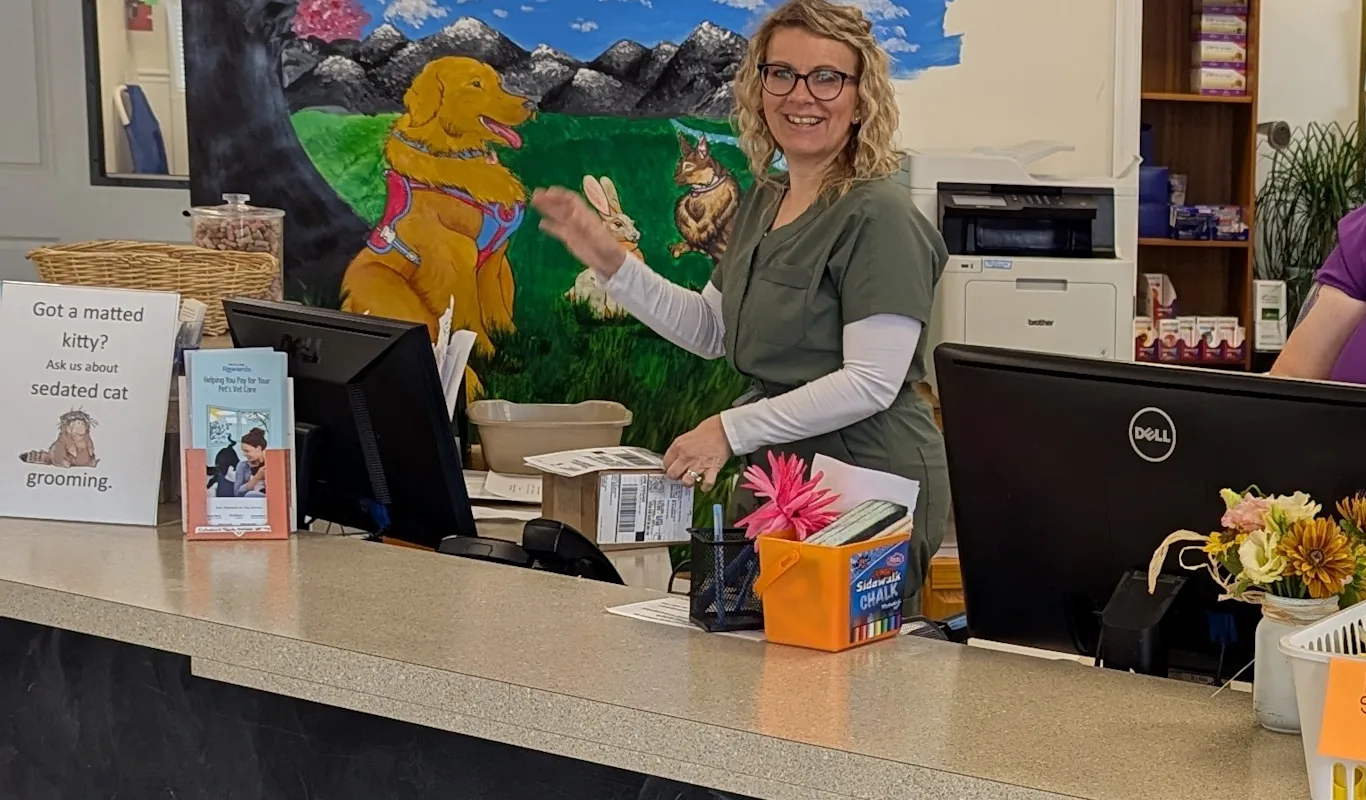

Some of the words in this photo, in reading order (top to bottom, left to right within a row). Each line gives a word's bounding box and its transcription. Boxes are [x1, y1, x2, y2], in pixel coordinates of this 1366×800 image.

[33, 301, 64, 318] Got
[68, 306, 78, 319] a
[83, 307, 144, 322] matted
[1028, 318, 1054, 326] brother
[62, 332, 109, 352] kitty?
[45, 359, 67, 370] Ask
[69, 362, 82, 372] us
[84, 361, 120, 373] about
[30, 381, 99, 399] sedated
[103, 386, 129, 401] cat
[203, 376, 225, 385] Helping
[237, 376, 247, 386] Pay
[248, 376, 257, 384] for
[1134, 425, 1171, 443] DELL
[26, 472, 113, 492] grooming.
[856, 571, 901, 592] Sidewalk
[859, 582, 899, 610] CHALK
